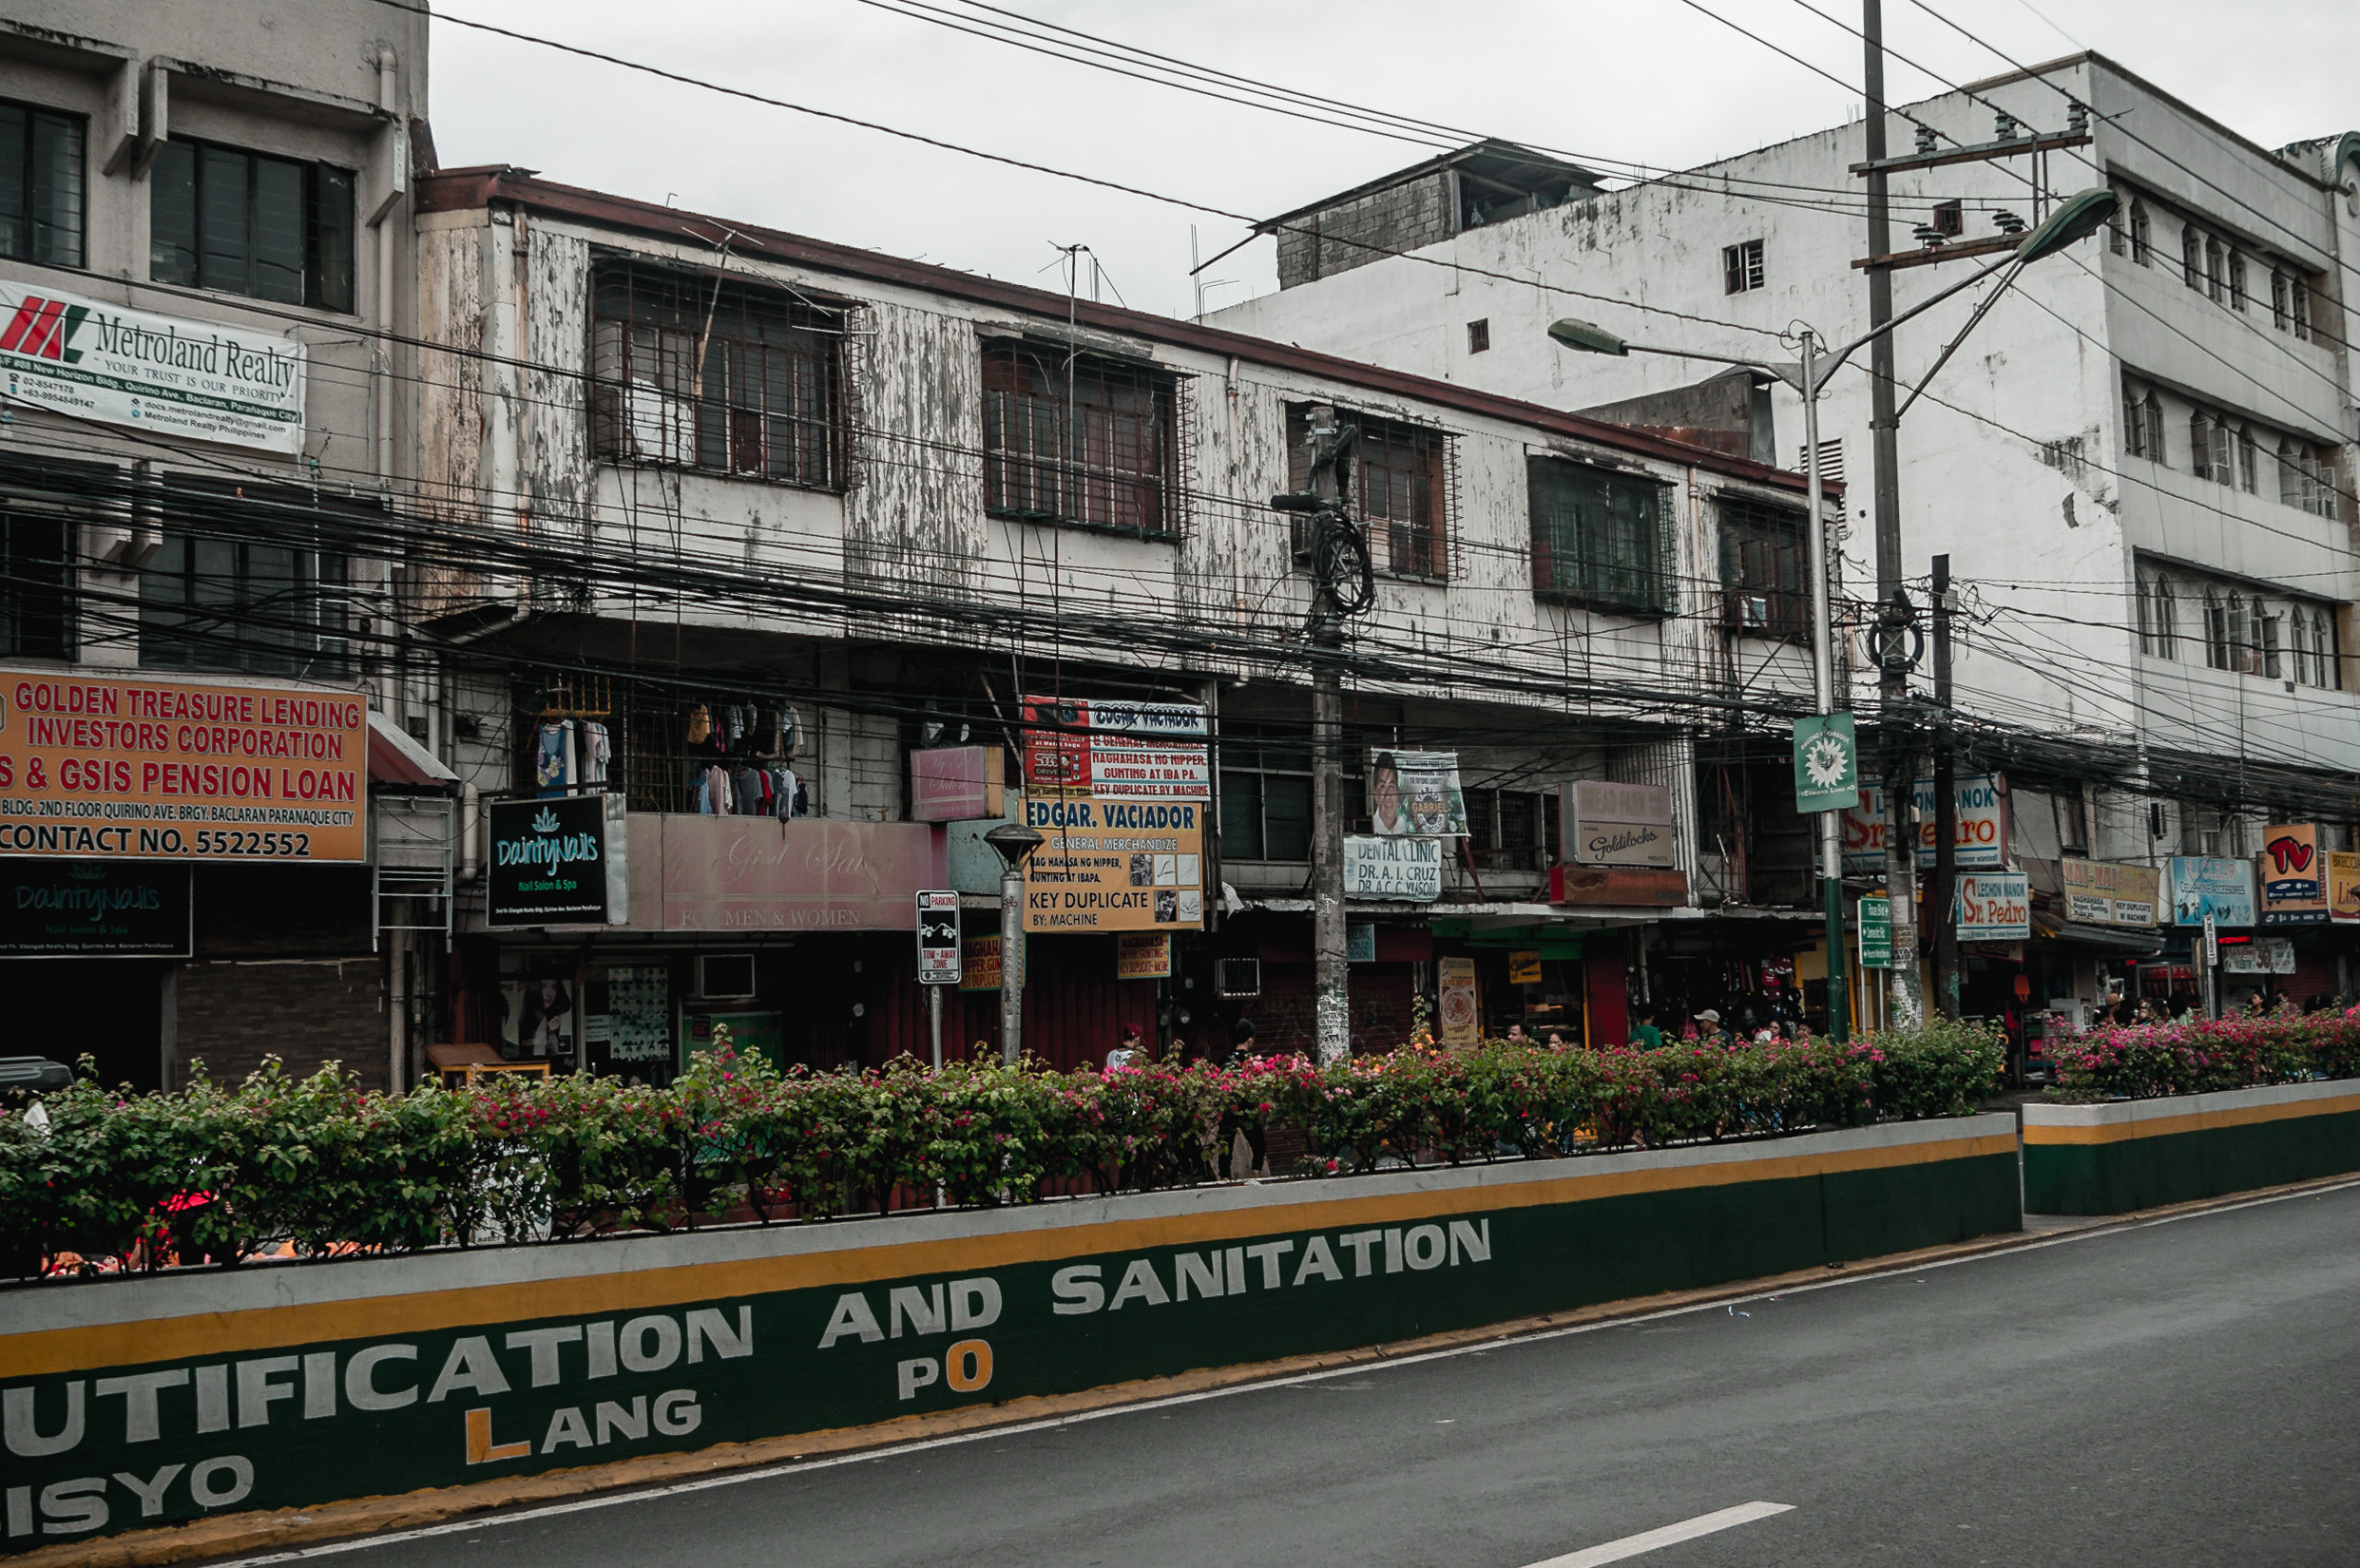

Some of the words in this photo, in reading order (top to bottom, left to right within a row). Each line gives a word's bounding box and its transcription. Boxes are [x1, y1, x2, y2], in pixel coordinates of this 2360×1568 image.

[95, 314, 218, 375] Metroland
[224, 339, 295, 388] Realty
[106, 360, 139, 376] YOUR
[144, 368, 181, 384] TRUST
[187, 374, 196, 387] IS
[201, 380, 226, 393] OUR
[232, 385, 283, 403] PRIORITY
[125, 382, 160, 396] Quirino
[144, 411, 188, 426] Metroland
[190, 420, 217, 431] Realty
[219, 425, 266, 439] Philippines
[14, 681, 119, 716] GOLDEN
[127, 688, 254, 724] TREASURE
[260, 696, 360, 731] LENDING
[28, 717, 171, 753] INVESTORS
[177, 724, 343, 760] CORPORATION
[1093, 752, 1152, 764] NAGHAHASA
[1155, 755, 1168, 765] NG
[1171, 755, 1207, 766] NIPPER,
[26, 755, 49, 792] &
[60, 758, 132, 793] GSIS
[143, 762, 272, 799] PENSION
[282, 768, 355, 802] LOAN
[1104, 768, 1146, 779] GUNTING
[1149, 769, 1161, 779] AT
[1163, 769, 1179, 779] IBA
[1182, 769, 1199, 780] PA.
[1094, 784, 1110, 794] KEY
[1113, 784, 1158, 795] DUPLICATE
[1160, 785, 1171, 794] BY
[1173, 785, 1209, 796] MACHINE
[2, 799, 36, 816] BLDG.
[38, 800, 63, 817] 2ND
[66, 801, 102, 818] FLOOR
[104, 803, 150, 821] QUIRINO
[153, 805, 177, 820] AVE.
[180, 806, 209, 821] BRGY.
[211, 807, 266, 823] BACLARAN
[269, 810, 330, 827] PARANAQUE
[333, 811, 355, 826] CITY
[1412, 802, 1448, 814] GABRIEL
[1103, 804, 1195, 830] VACIADOR
[0, 823, 133, 852] CONTACT
[139, 827, 189, 853] NO.
[195, 830, 311, 855] 5522552
[1050, 836, 1100, 850] GENERAL
[1103, 837, 1179, 851] MERCHANDIZE
[1589, 827, 1659, 861] Goldilocks
[1358, 842, 1401, 861] DENTAL
[1404, 842, 1438, 863] CLINIC
[2267, 836, 2313, 874] TV
[1048, 857, 1078, 868] HAHASA
[1081, 857, 1091, 868] NG
[1094, 857, 1122, 870] NIPPER,
[1030, 872, 1065, 883] GUNTING
[1359, 864, 1378, 879] DR.
[1407, 867, 1436, 881] CRUZ
[519, 881, 533, 891] Nail
[534, 880, 554, 890] Salon
[555, 879, 563, 889] &
[563, 879, 577, 891] Spa
[1977, 883, 2002, 897] LECHON
[2004, 883, 2025, 897] MANOK
[919, 894, 930, 907] NO
[931, 896, 955, 906] PARKING
[1029, 892, 1059, 908] KEY
[1065, 892, 1148, 908] DUPLICATE
[1963, 878, 1984, 923] Sr.
[1987, 900, 2026, 923] Pedro
[2127, 902, 2151, 912] DUPLICATE
[725, 908, 767, 926] MEN
[772, 909, 786, 926] &
[791, 908, 860, 926] WOMEN
[1033, 914, 1046, 926] BY:
[1049, 914, 1098, 926] MACHINE
[46, 925, 66, 935] Nail
[68, 925, 96, 935] Salon
[109, 925, 128, 936] Spa
[1350, 941, 1369, 950] CRUZ
[923, 949, 935, 959] TOW
[940, 949, 956, 959] AWAY
[1350, 950, 1370, 960] YUSON
[933, 959, 948, 968] ZONE
[2, 1305, 754, 1457] UTIFICATION
[816, 1275, 1003, 1348] AND
[1052, 1218, 1491, 1315] SANITATION
[5, 1454, 256, 1539] ISYO
[464, 1388, 702, 1466] LANG
[897, 1338, 994, 1400] PO
